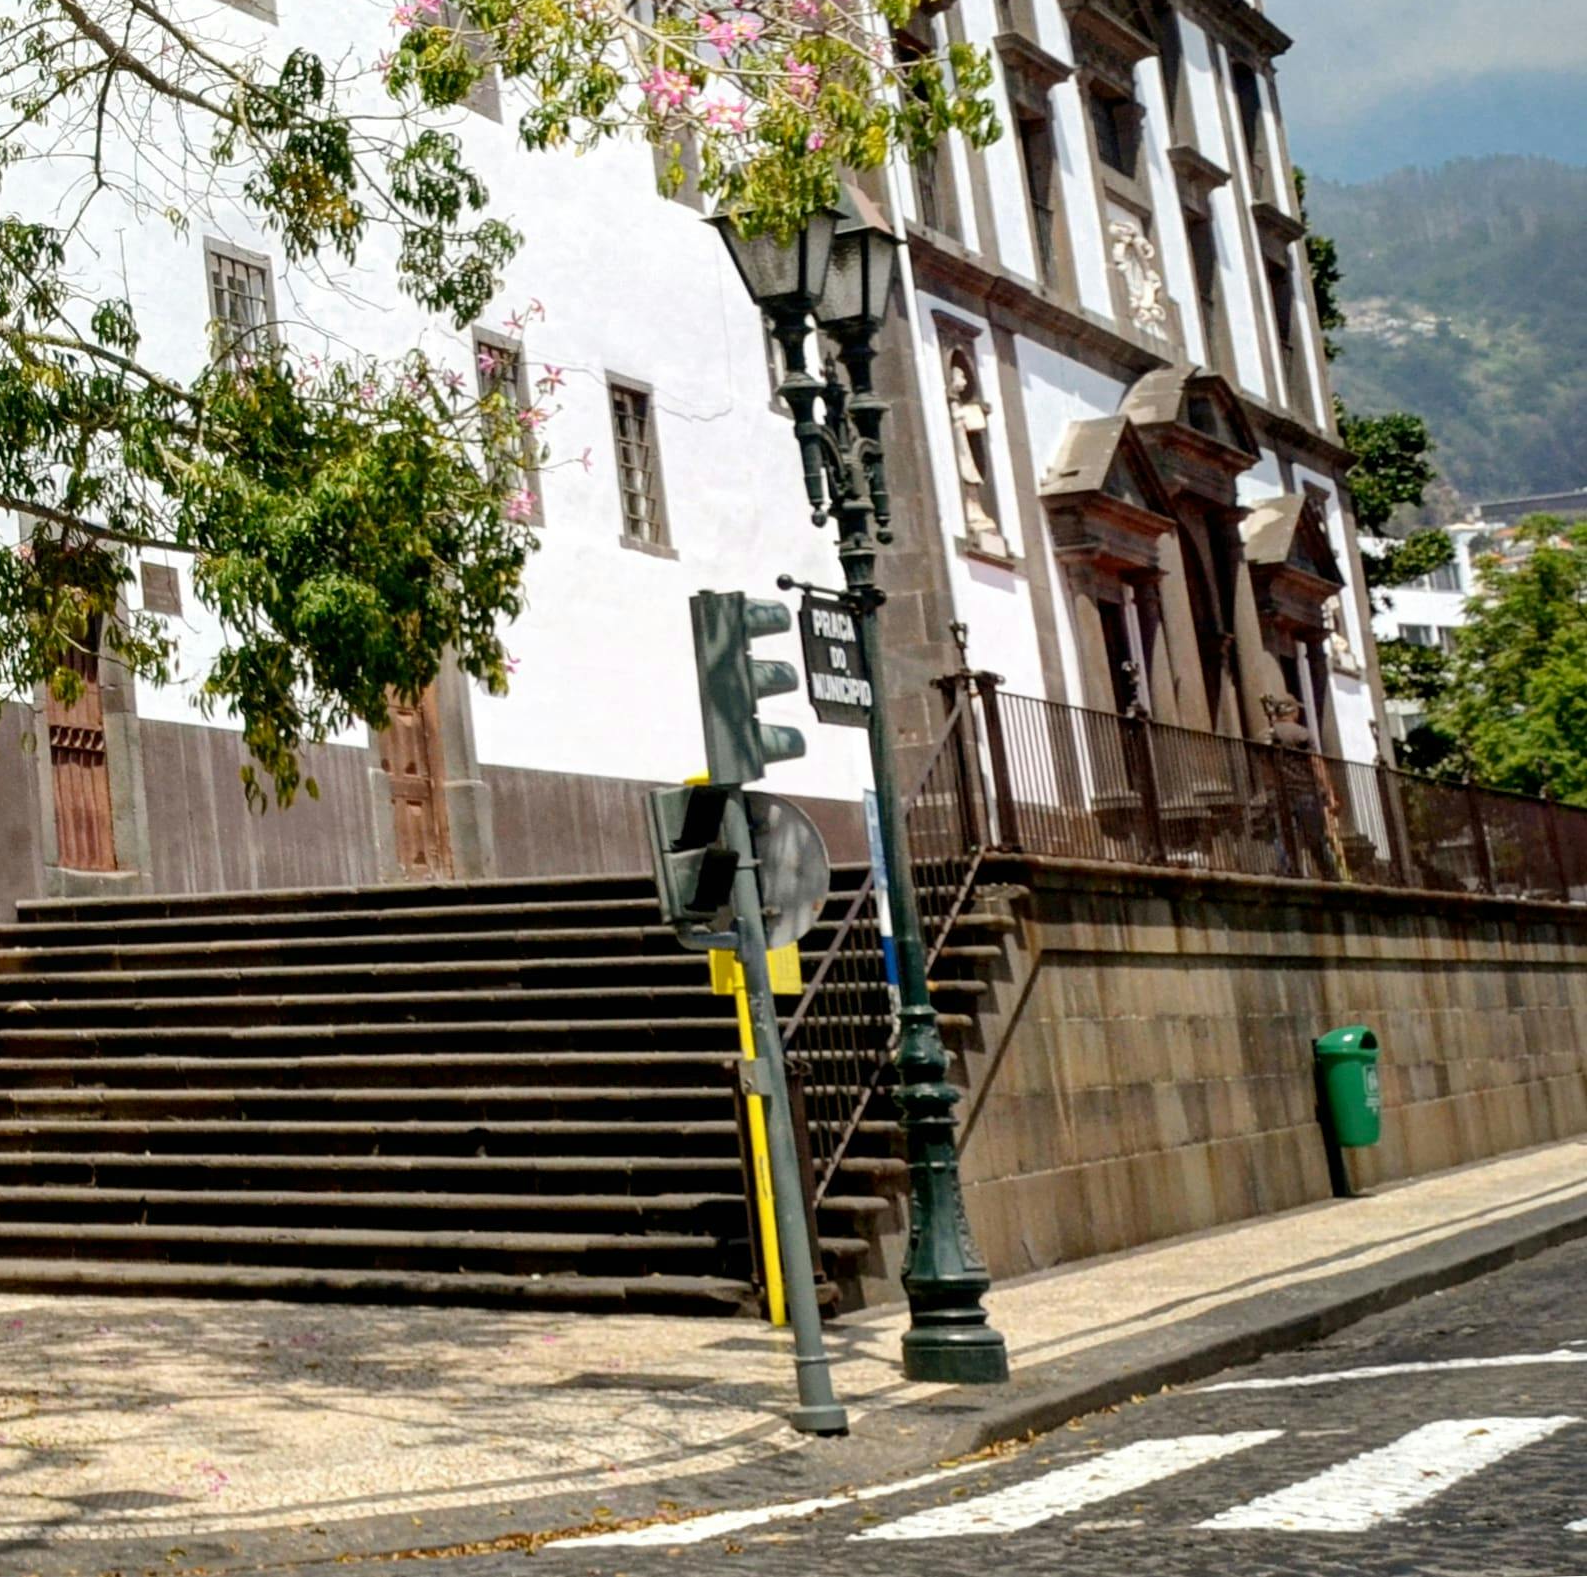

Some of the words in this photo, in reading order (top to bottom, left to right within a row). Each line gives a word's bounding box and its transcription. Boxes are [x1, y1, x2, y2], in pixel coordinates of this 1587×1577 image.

[811, 608, 856, 643] PRAÇA
[829, 645, 847, 670] DO
[811, 669, 873, 707] MUNICÍPIO
